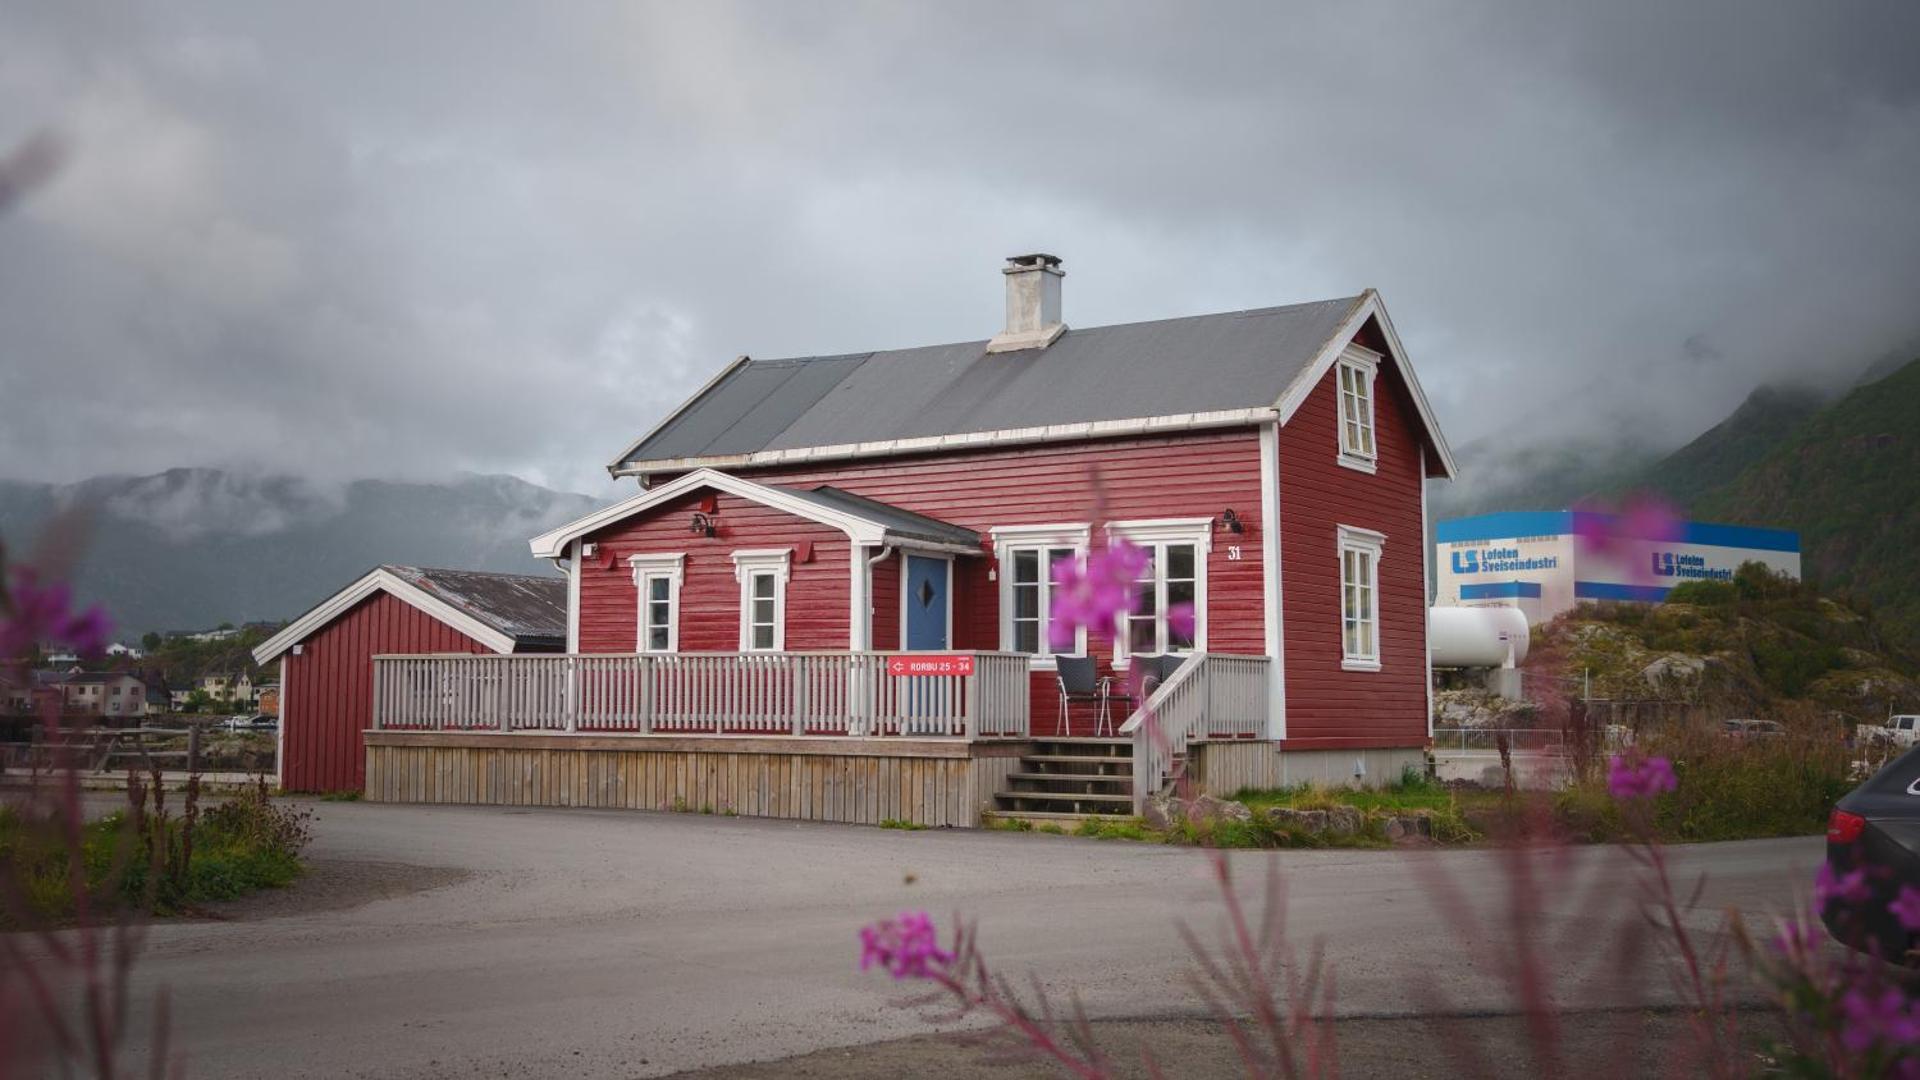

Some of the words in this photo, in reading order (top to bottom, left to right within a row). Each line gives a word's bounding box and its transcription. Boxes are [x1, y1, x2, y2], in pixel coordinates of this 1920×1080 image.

[1228, 545, 1241, 560] 31
[1481, 548, 1519, 560] Lofoten
[1676, 553, 1705, 566] Lofoten
[1452, 550, 1479, 574] LS
[1481, 556, 1557, 572] Sveiseindustri
[910, 662, 938, 671] RORBU
[939, 662, 951, 671] 25
[958, 662, 970, 671] 34
